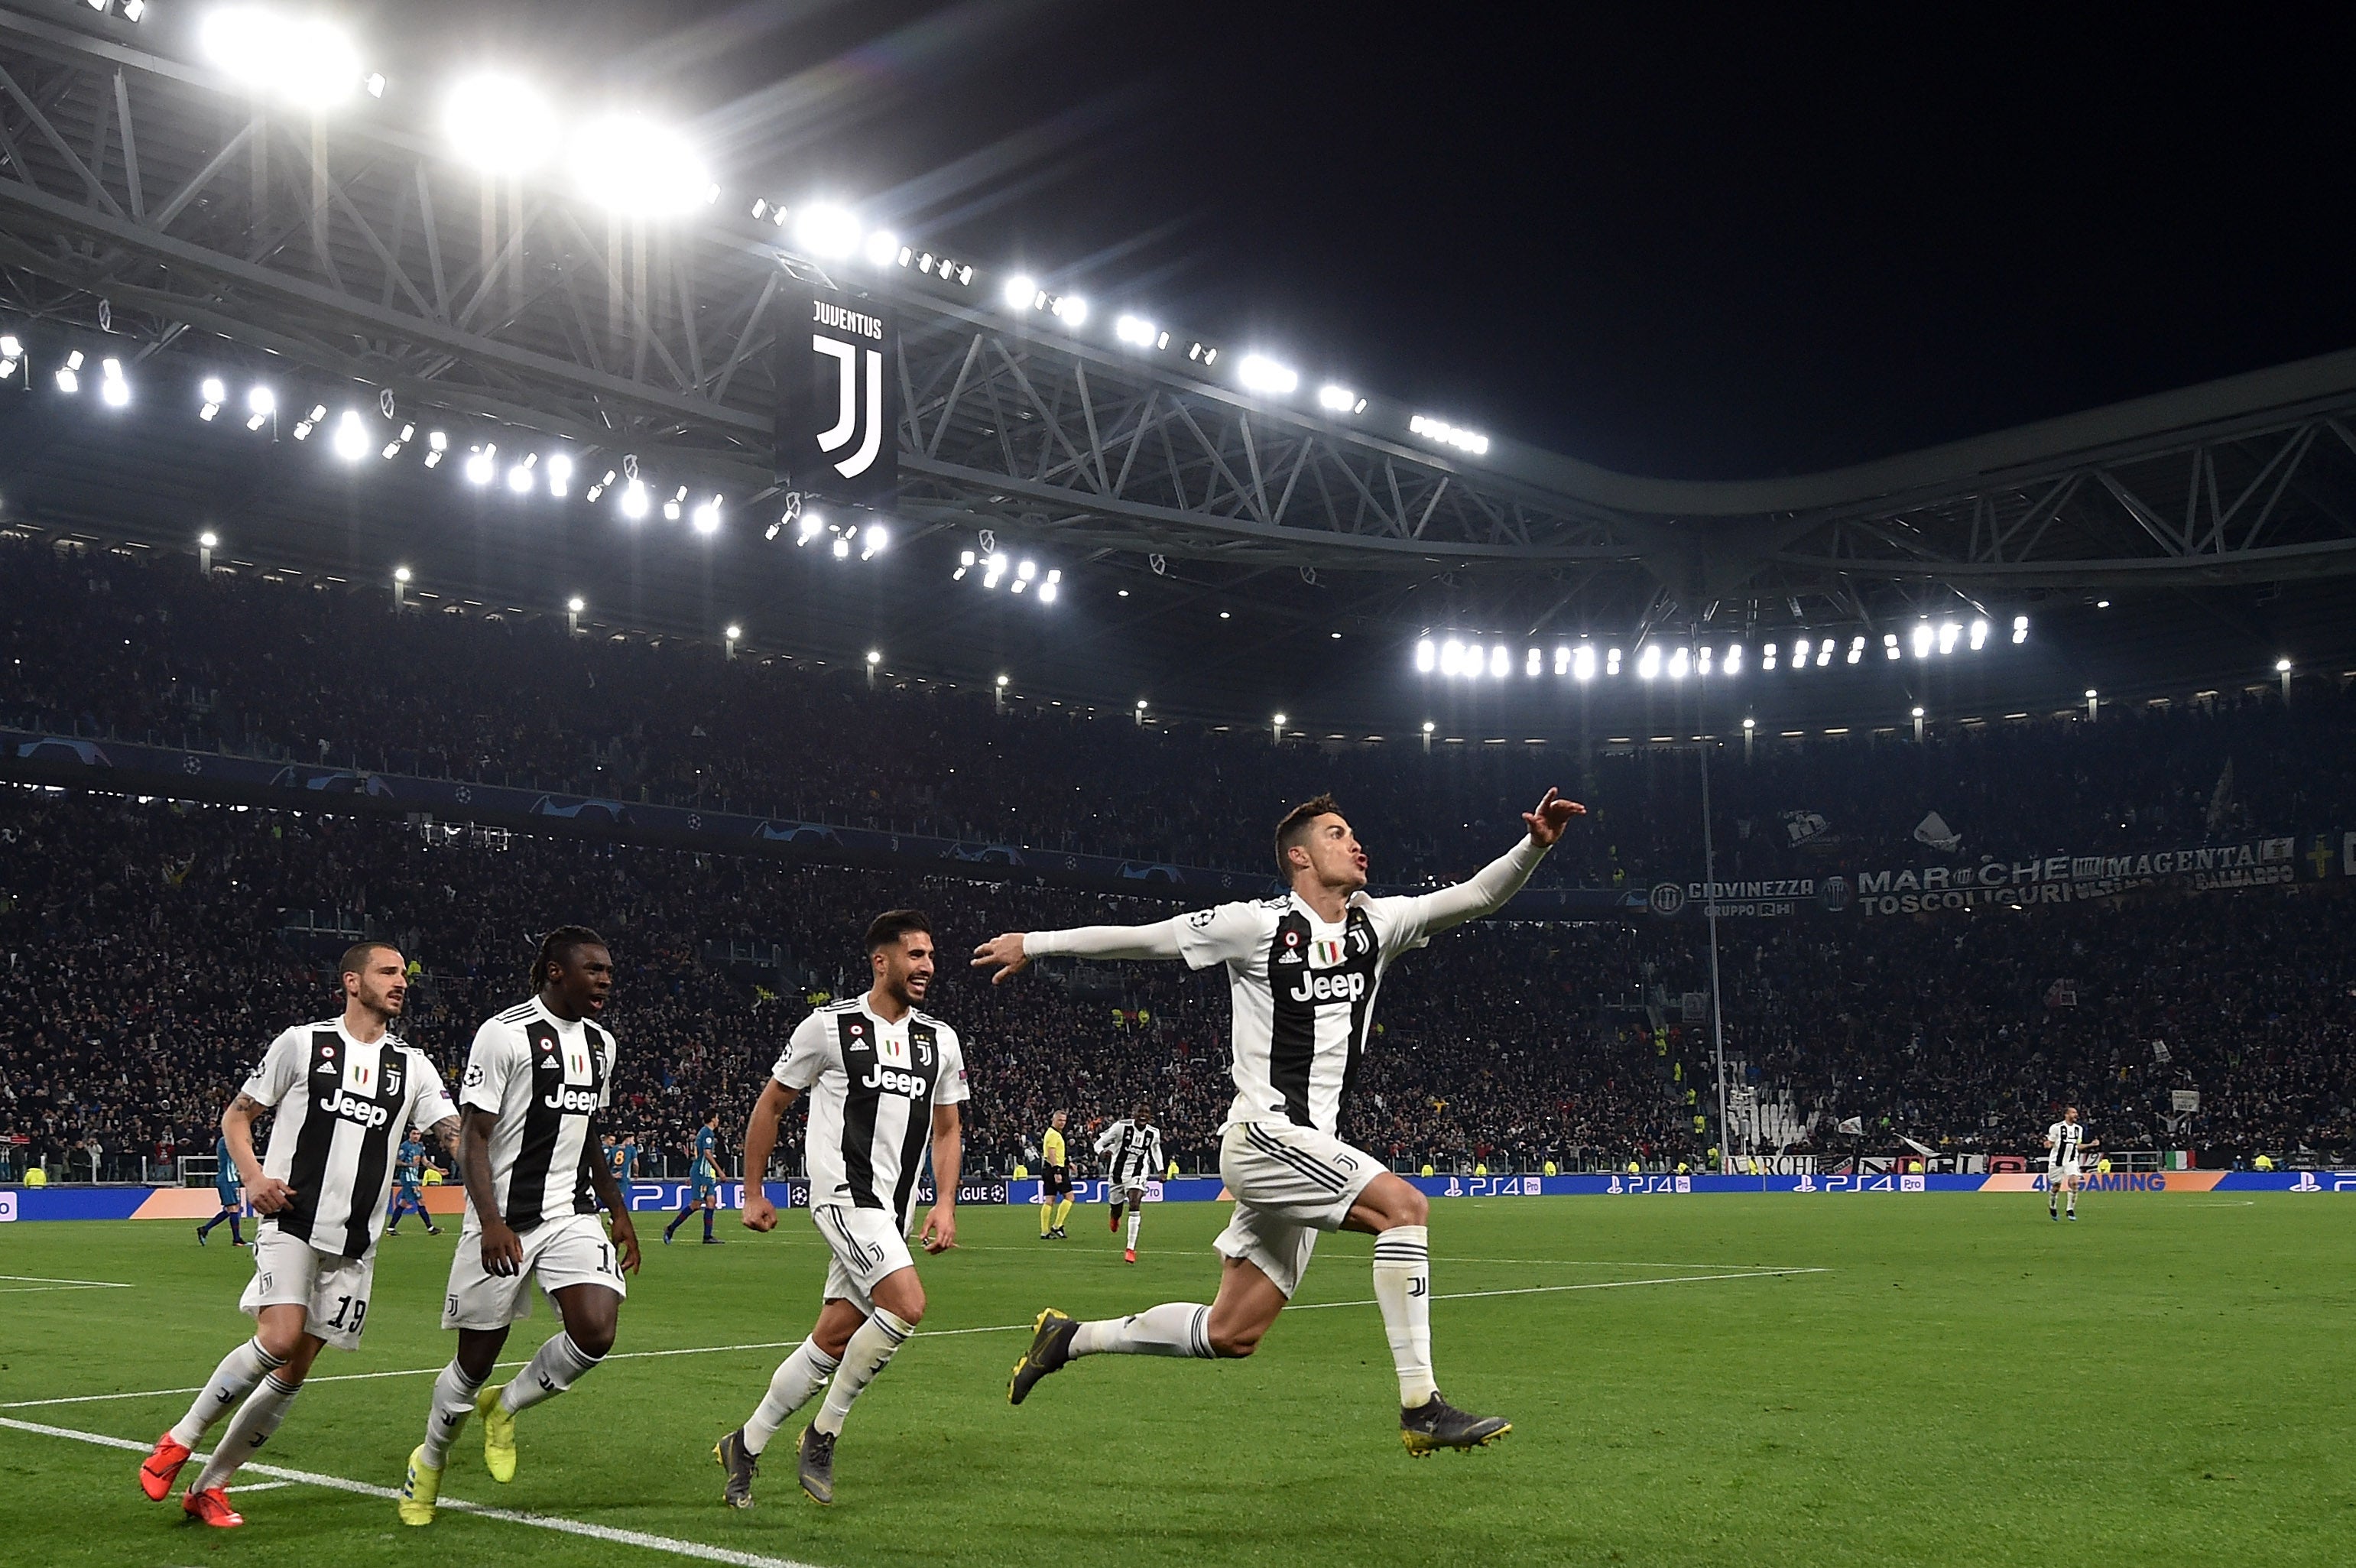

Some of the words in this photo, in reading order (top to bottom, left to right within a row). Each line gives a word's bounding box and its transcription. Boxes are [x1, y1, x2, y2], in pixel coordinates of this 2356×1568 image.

[813, 300, 882, 339] JUVENTUS
[2104, 844, 2255, 878] MAGENTA
[1687, 879, 1814, 898] GIOVINEZZA
[1704, 904, 1755, 917] GRUPPO
[1290, 970, 1365, 1002] Jeep
[862, 1063, 926, 1099] Jeep
[320, 1088, 388, 1128] Jeep
[544, 1083, 598, 1116] Jeep
[614, 1150, 625, 1165] 8
[958, 1187, 988, 1201] GUE
[1469, 1177, 1520, 1196] PS4
[1527, 1182, 1539, 1192] Pro
[1628, 1176, 1673, 1193] PS4
[1677, 1180, 1688, 1190] Pro
[1825, 1175, 1895, 1193] PS4
[1903, 1178, 1921, 1190] Pro
[328, 1296, 366, 1333] 19
